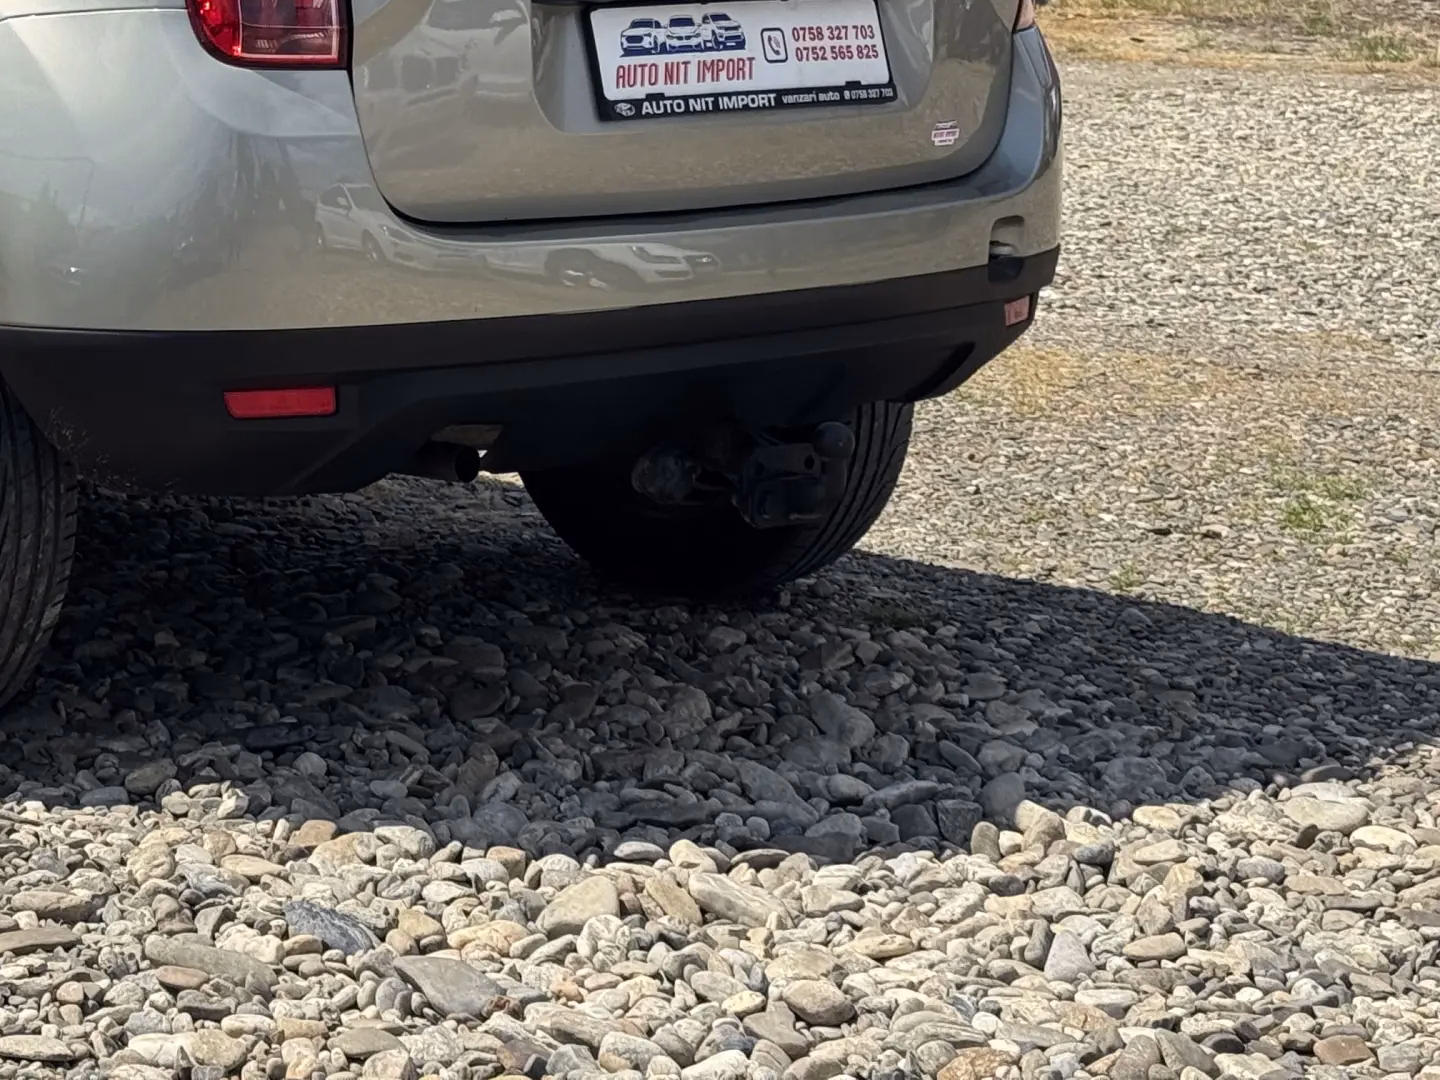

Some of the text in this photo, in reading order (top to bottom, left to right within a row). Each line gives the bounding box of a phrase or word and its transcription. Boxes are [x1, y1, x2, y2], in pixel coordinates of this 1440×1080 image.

[791, 24, 875, 42] 0758 327 703
[795, 44, 879, 62] 0752 565 825
[615, 56, 756, 89] AUTO NIT IMPORT
[641, 99, 686, 115] AUTO
[689, 97, 715, 112] NIT
[718, 93, 777, 110] IMPORT
[781, 91, 817, 104] vanzari
[818, 91, 841, 102] auto
